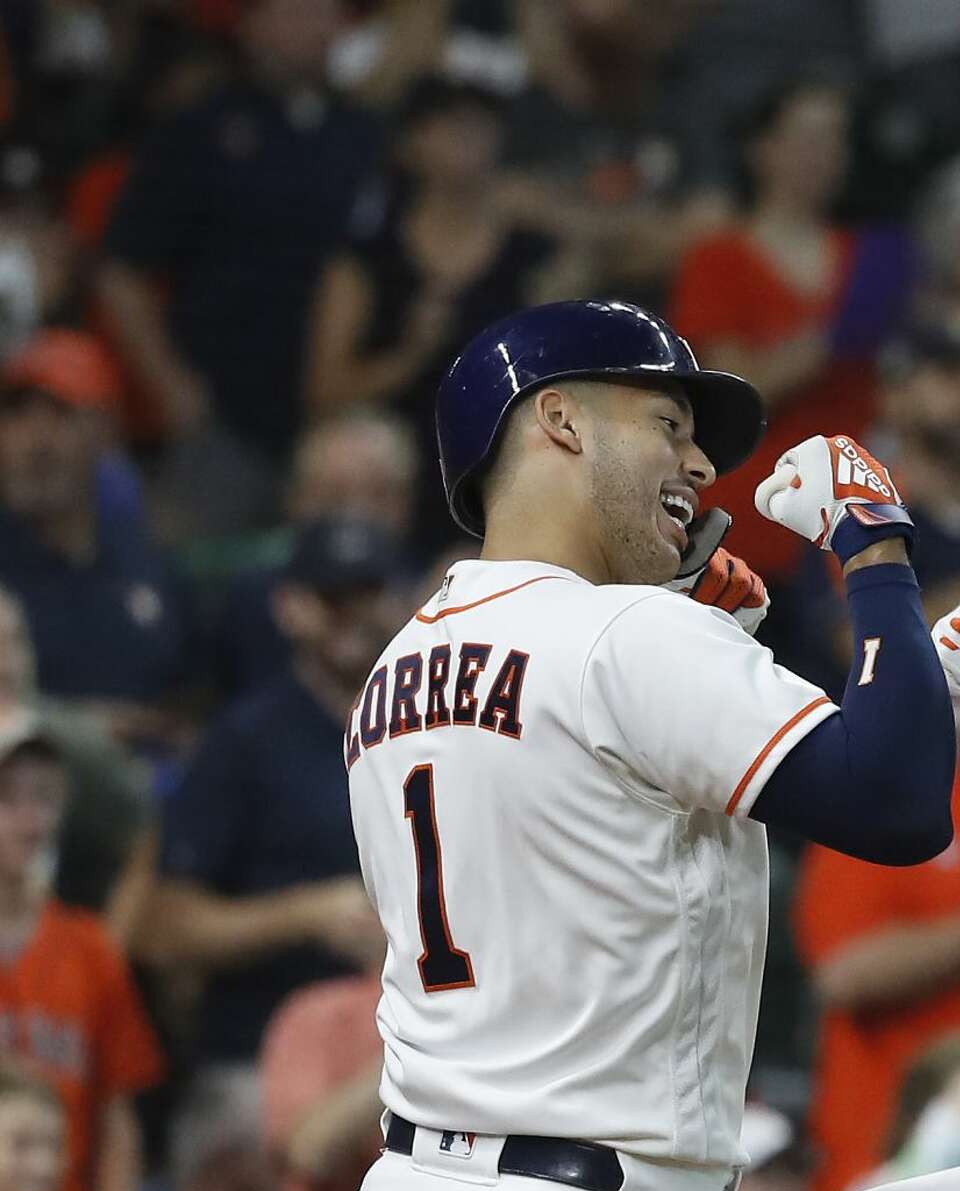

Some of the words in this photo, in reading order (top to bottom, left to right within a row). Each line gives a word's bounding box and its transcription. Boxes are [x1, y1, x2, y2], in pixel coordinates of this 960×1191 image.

[835, 437, 891, 498] adidas
[344, 642, 530, 769] CORREA
[403, 763, 476, 992] 1
